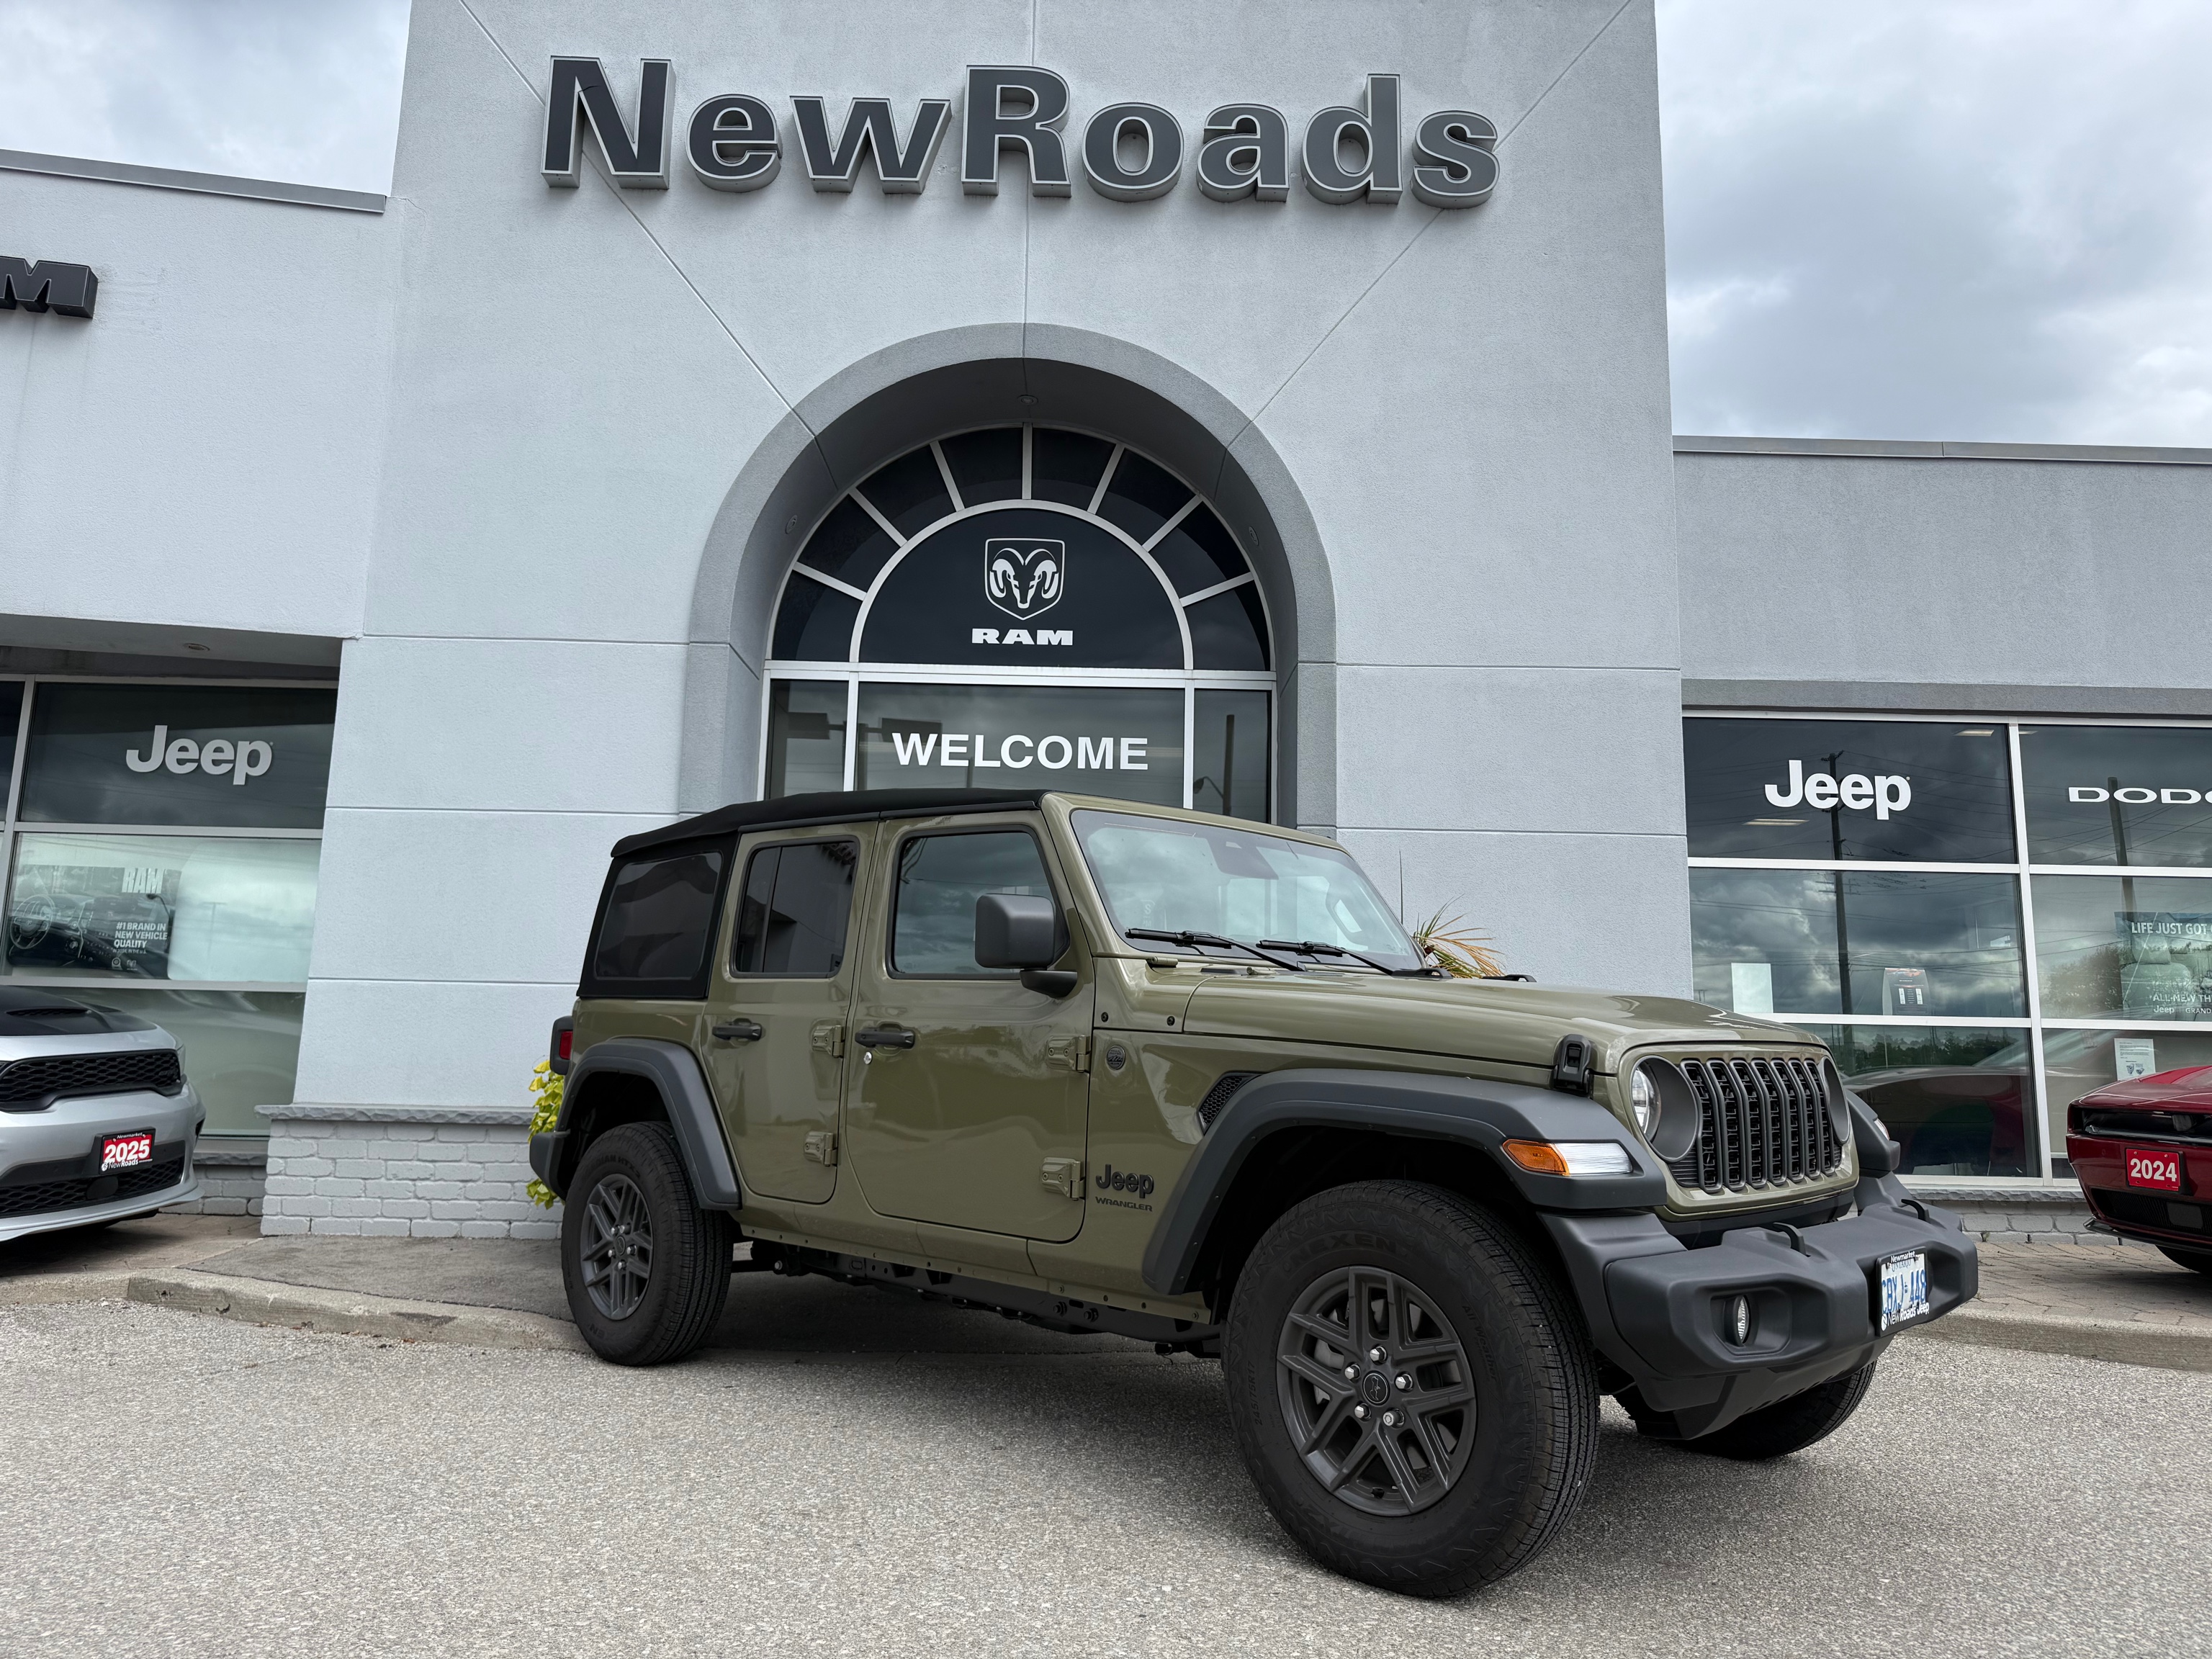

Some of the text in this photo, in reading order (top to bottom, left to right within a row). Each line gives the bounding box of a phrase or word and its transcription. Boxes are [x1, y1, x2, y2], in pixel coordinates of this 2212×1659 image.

[541, 55, 1503, 208] NewRoads
[972, 628, 1073, 645] RAM
[125, 724, 273, 786] Jeep
[891, 732, 1149, 770] WELCOME
[1763, 759, 1912, 820] Jeep
[2068, 786, 2212, 804] DOD
[122, 867, 164, 894] RAM
[115, 930, 168, 940] NEW VEHICLE
[116, 922, 126, 930] #1
[127, 922, 156, 931] BRAND
[2131, 922, 2153, 934] LIFE
[2155, 922, 2182, 935] JUST
[2185, 923, 2208, 935] GOT
[114, 939, 148, 948] QUALITY
[2154, 1005, 2175, 1015] Jeep
[104, 1139, 150, 1164] 2025
[2130, 1158, 2177, 1182] 2024
[1095, 1164, 1154, 1199] Jeep
[1095, 1196, 1153, 1212] WRANGLER
[1290, 1233, 1396, 1268] NEXEN
[1891, 1251, 1915, 1264] Newmarket
[1910, 1269, 1926, 1305] 448
[1917, 1301, 1930, 1316] Jeep
